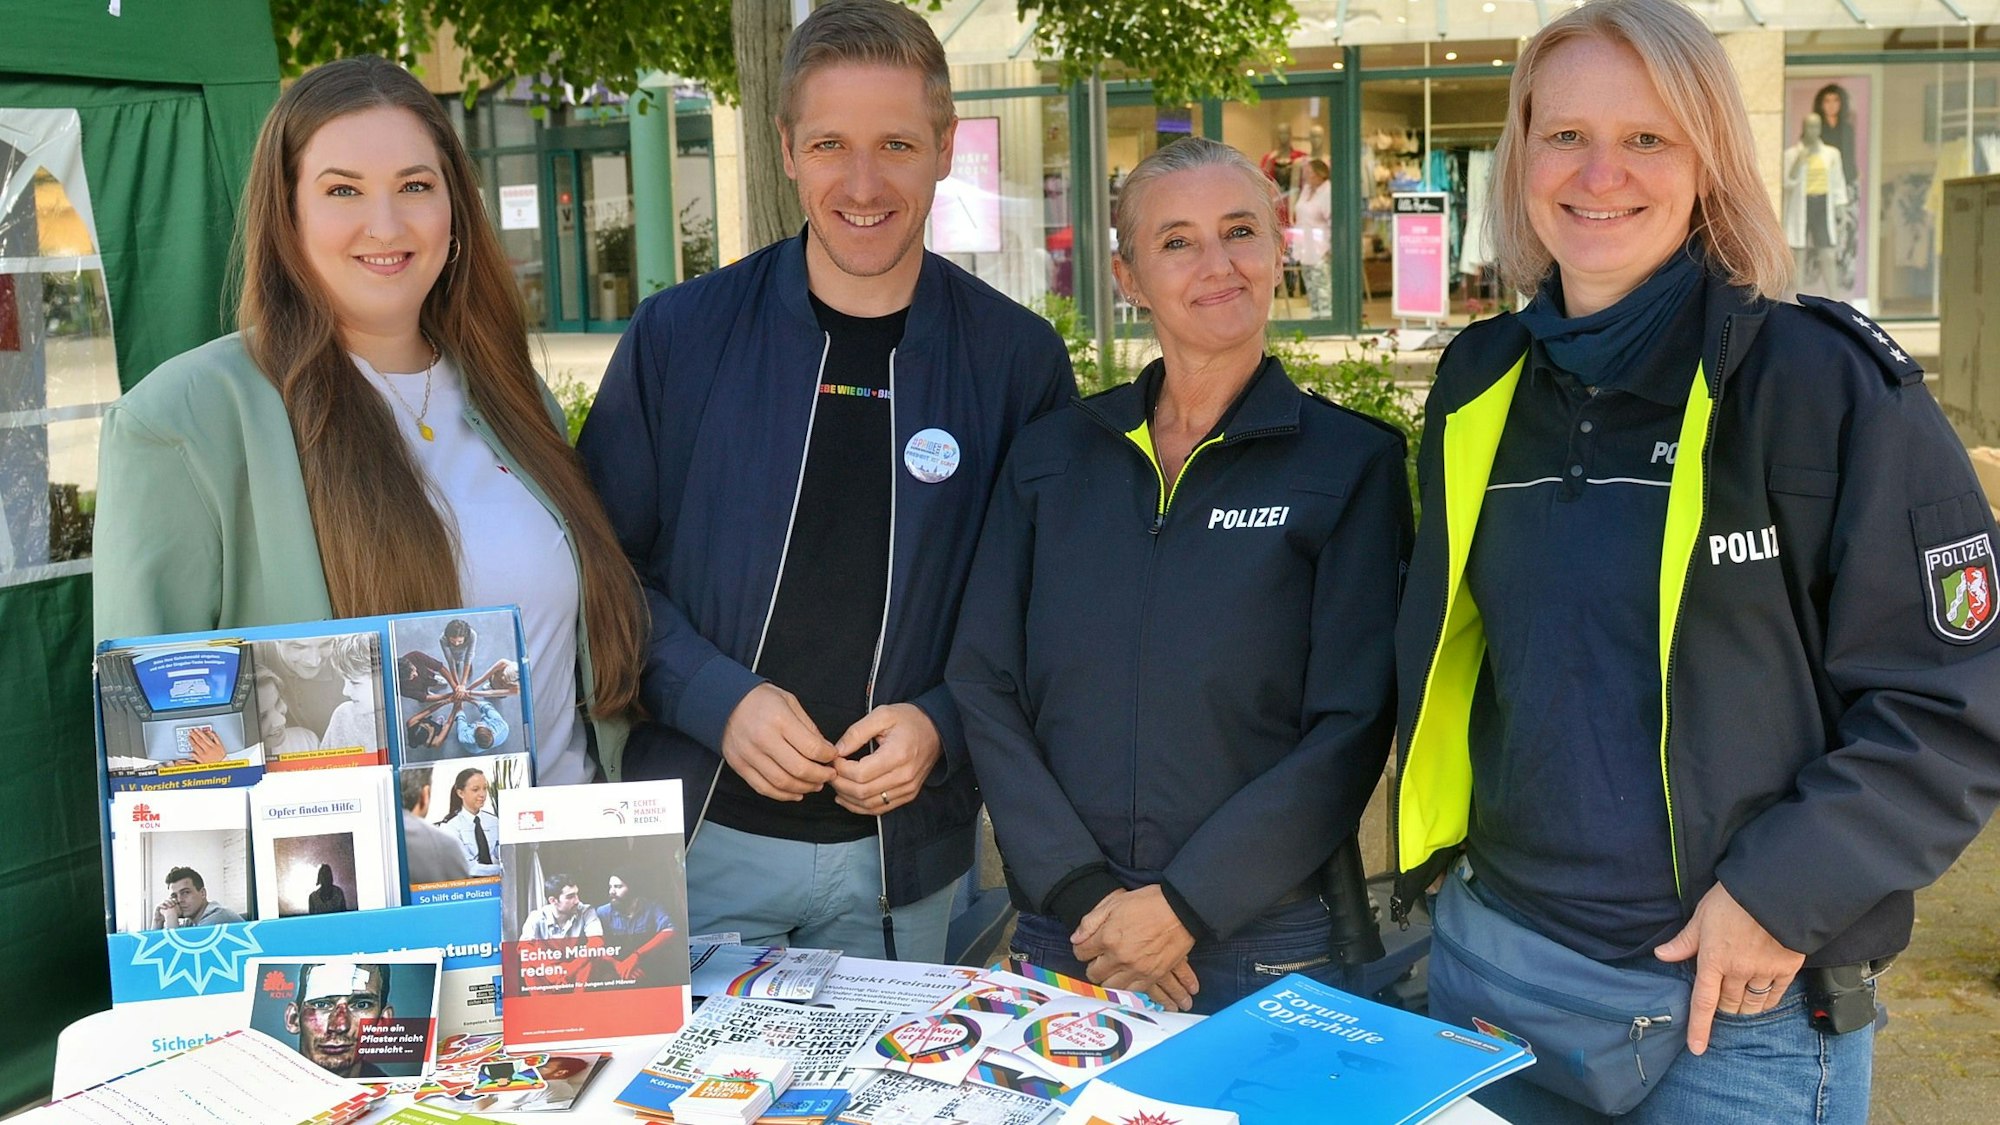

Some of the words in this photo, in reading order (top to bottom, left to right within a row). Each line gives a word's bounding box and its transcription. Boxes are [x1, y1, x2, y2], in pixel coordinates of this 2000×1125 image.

[820, 383, 837, 394] EBE
[837, 384, 856, 396] WIE
[856, 386, 871, 397] DU
[877, 389, 892, 399] BIS
[1207, 506, 1290, 530] POLIZEI
[1708, 524, 1780, 566] POLIZ
[1929, 538, 1990, 571] POLIZEI
[141, 779, 180, 792] Vorsicht
[181, 775, 232, 788] Skimming!
[268, 807, 296, 819] Opfer
[299, 805, 329, 815] finden
[331, 801, 355, 812] Hilfe
[633, 799, 658, 807] ECHTE
[132, 812, 160, 822] SKM
[634, 815, 662, 824] REDEN.
[419, 895, 431, 904] So
[432, 892, 449, 902] hilft
[450, 891, 465, 900] die
[465, 888, 493, 899] Polizei
[520, 947, 562, 962] Echte
[565, 945, 621, 959] Männer
[520, 962, 568, 978] reden.
[830, 972, 885, 983] Projekt
[887, 978, 957, 990] Freiraum
[704, 1006, 742, 1018] NICHT
[735, 1004, 779, 1017] HABE
[741, 1001, 805, 1015] WURDEN
[1271, 989, 1360, 1025] Forum
[362, 1024, 390, 1033] Wenn
[390, 1025, 405, 1033] ein
[698, 1012, 757, 1029] AUCH
[762, 1024, 868, 1035] SEELISCHE
[1258, 999, 1385, 1045] Opferhilfe
[685, 1025, 724, 1039] SIE
[904, 1026, 927, 1034] Die
[932, 1026, 963, 1036] Welt
[1083, 1027, 1107, 1039] mag
[152, 1033, 214, 1053] Sicherh
[360, 1034, 399, 1044] Pflaster
[399, 1035, 424, 1043] nicht
[674, 1039, 708, 1050] DANN
[916, 1034, 955, 1043] bunt!
[1066, 1036, 1087, 1048] bist.
[1075, 1031, 1087, 1039] so
[1087, 1036, 1107, 1048] wie
[358, 1046, 403, 1054] ausreicht
[666, 1048, 695, 1059] UND
[671, 1044, 694, 1052] WIR
[656, 1055, 693, 1073] JE
[793, 1070, 837, 1082] EIT
[884, 1073, 911, 1081] SIE
[865, 1087, 898, 1097] DANN
[876, 1078, 928, 1092] NICHT
[855, 1095, 883, 1104] UND
